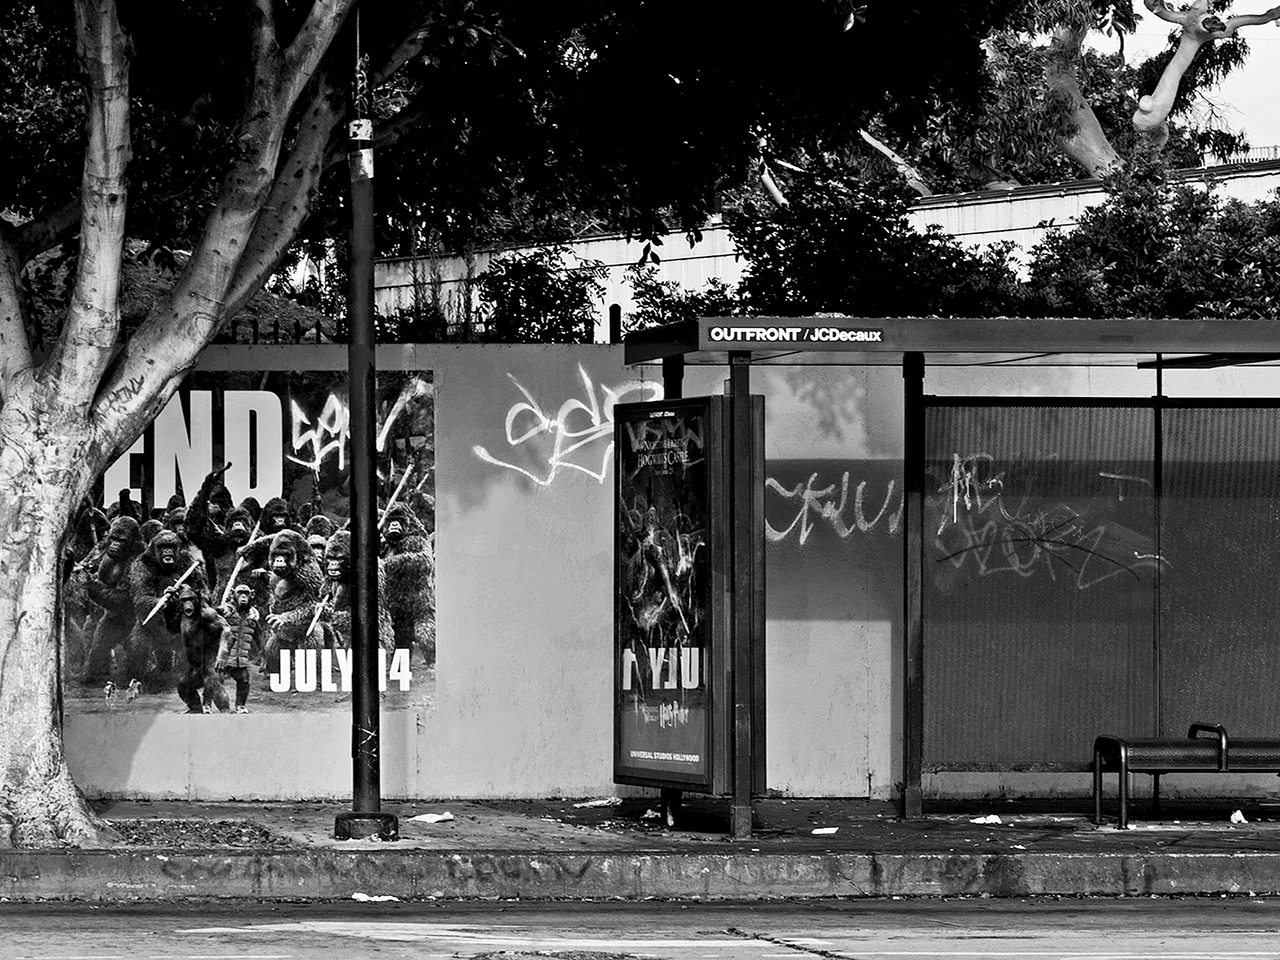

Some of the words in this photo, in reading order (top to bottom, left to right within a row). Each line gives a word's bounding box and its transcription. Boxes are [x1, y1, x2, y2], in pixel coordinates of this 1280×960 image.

[711, 327, 802, 341] OUTFRONT
[269, 648, 353, 692] JULY
[630, 750, 653, 759] UNIVERSAL
[653, 752, 672, 760] STUDIOS
[673, 753, 700, 763] HOLLYWOOD
